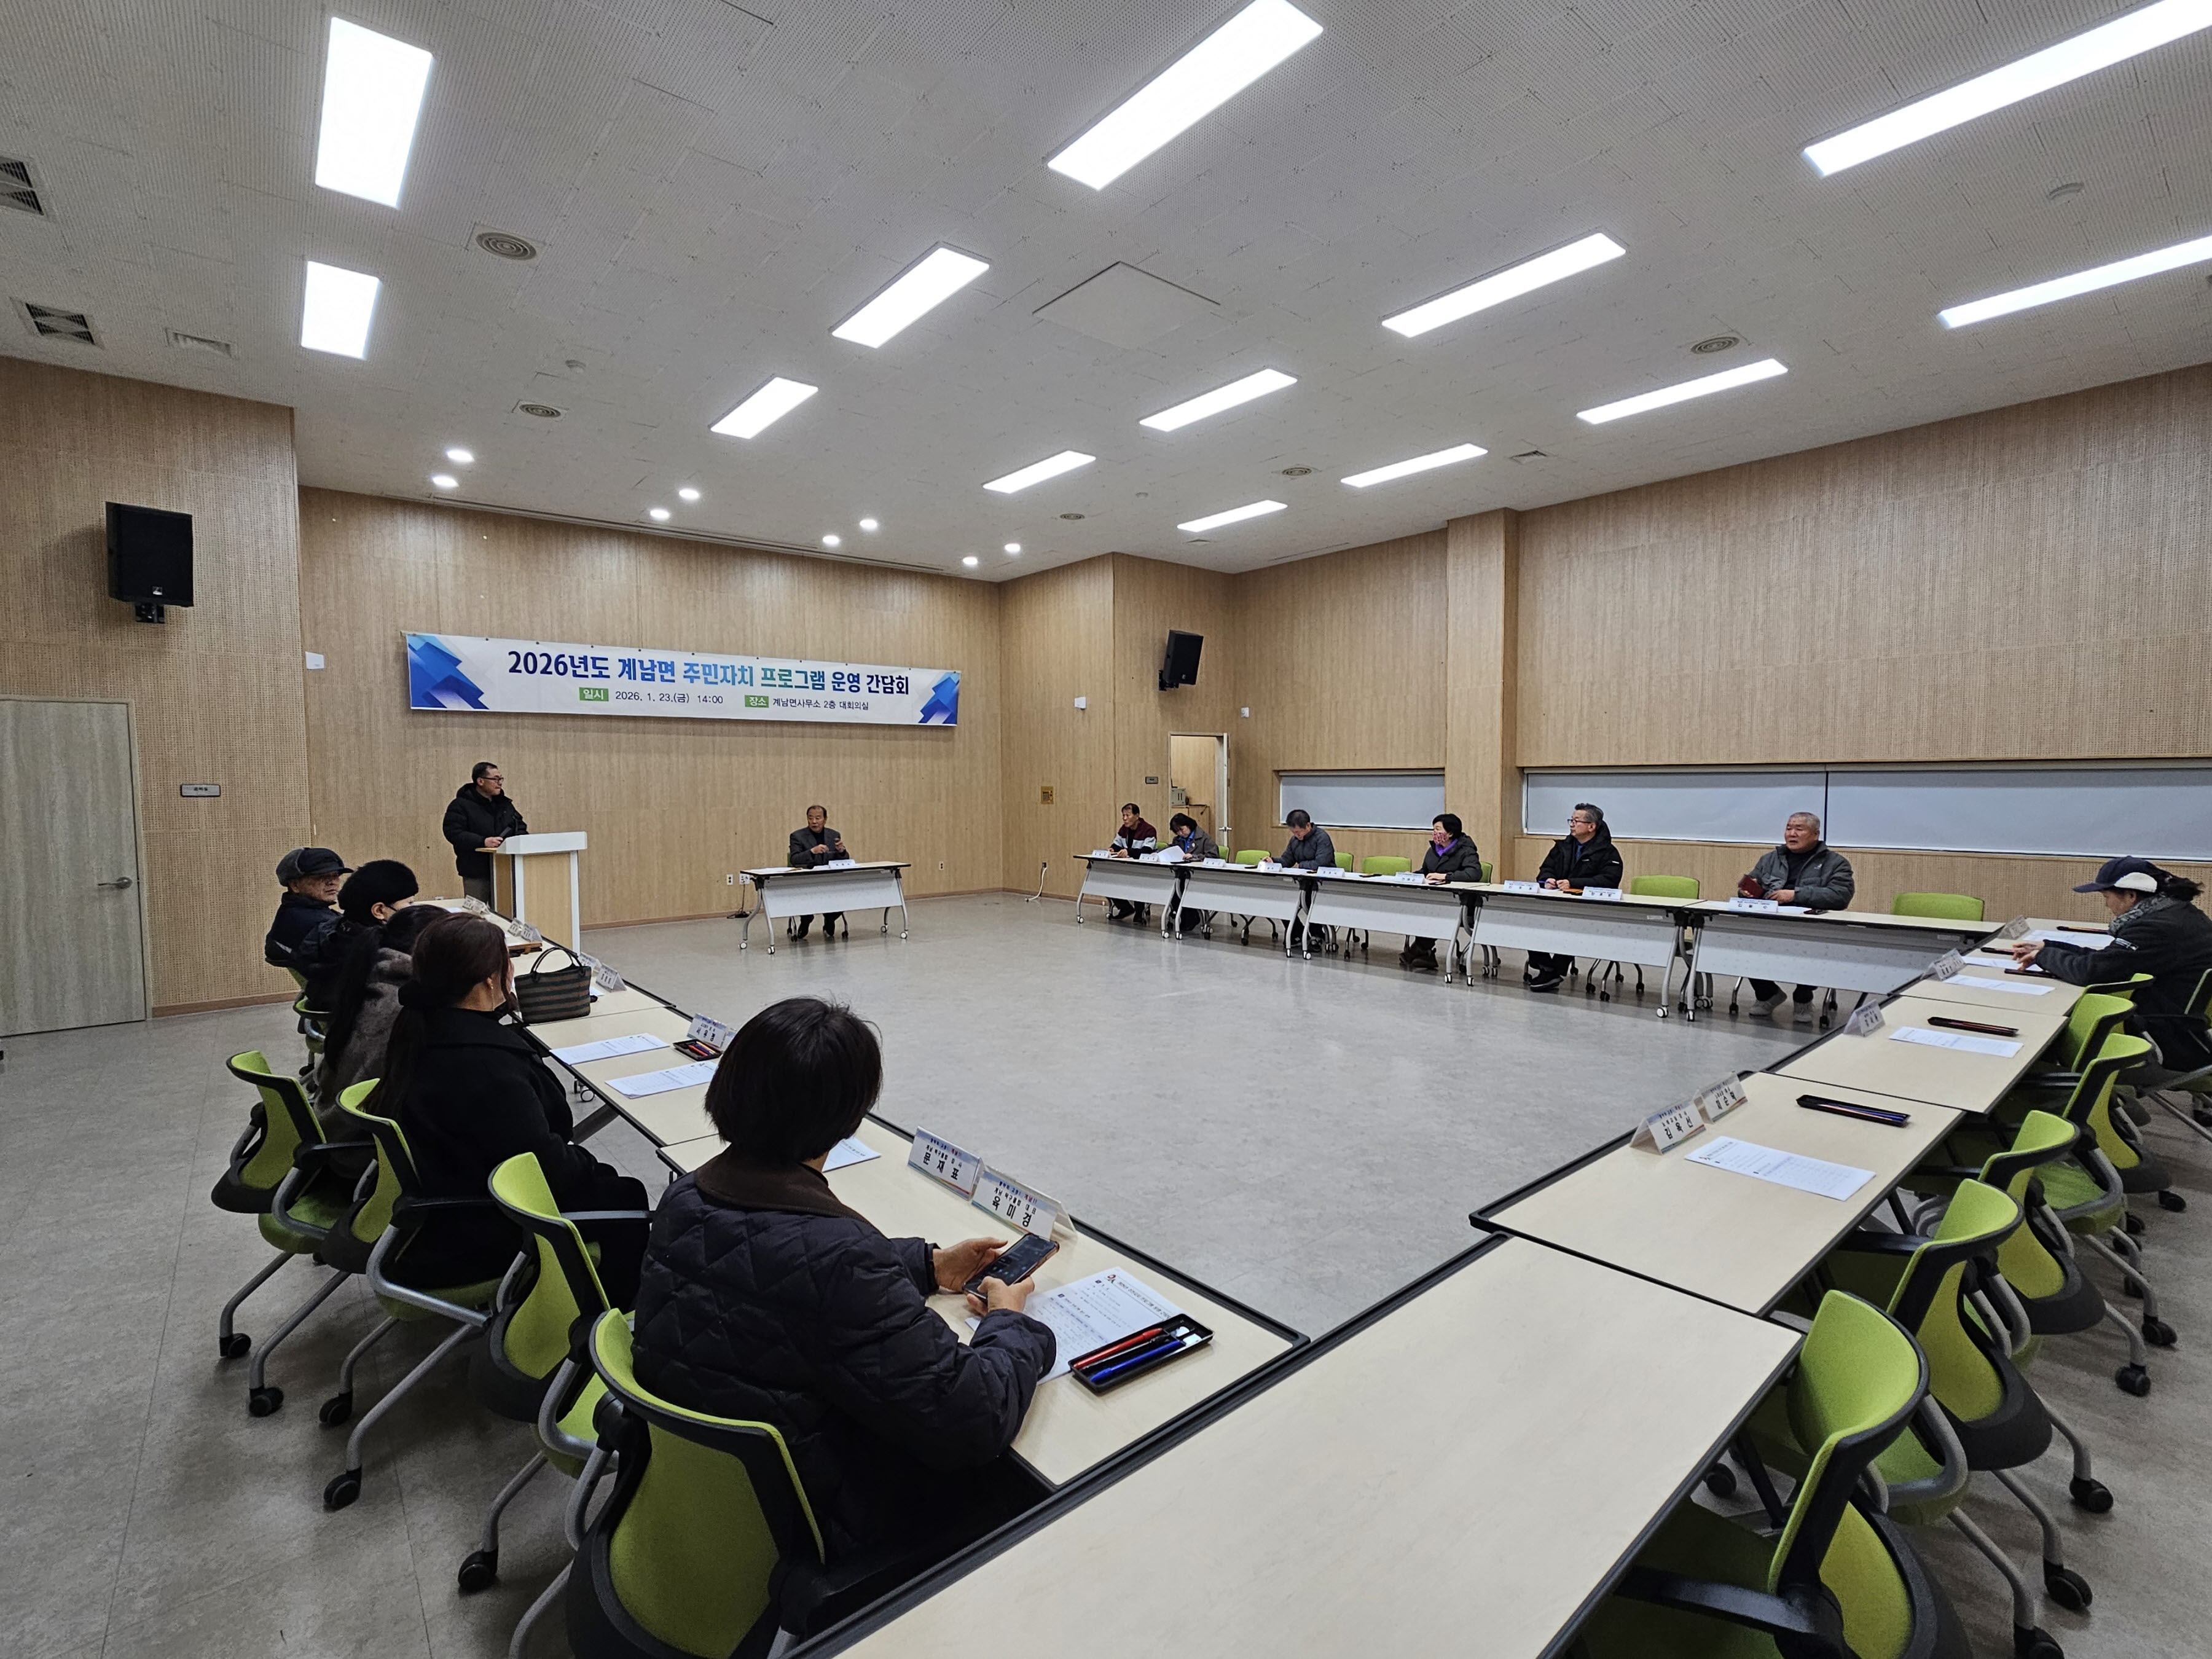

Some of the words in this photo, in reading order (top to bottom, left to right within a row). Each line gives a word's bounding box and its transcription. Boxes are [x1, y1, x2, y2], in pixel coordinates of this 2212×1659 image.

[508, 651, 611, 678] 2026년도
[618, 658, 675, 683] 계남면
[683, 662, 754, 686] 주민자치
[761, 667, 825, 691] 프로그램
[831, 672, 860, 692] 운영
[866, 675, 909, 695] 간담회
[583, 689, 605, 700] 일시
[616, 691, 643, 701] 2026.
[647, 693, 656, 702] 1.
[697, 695, 723, 704] 14:00
[749, 696, 767, 706] 장소
[773, 698, 821, 708] 계남면사무소
[824, 700, 836, 709] 2층
[839, 701, 869, 710] 대회의실
